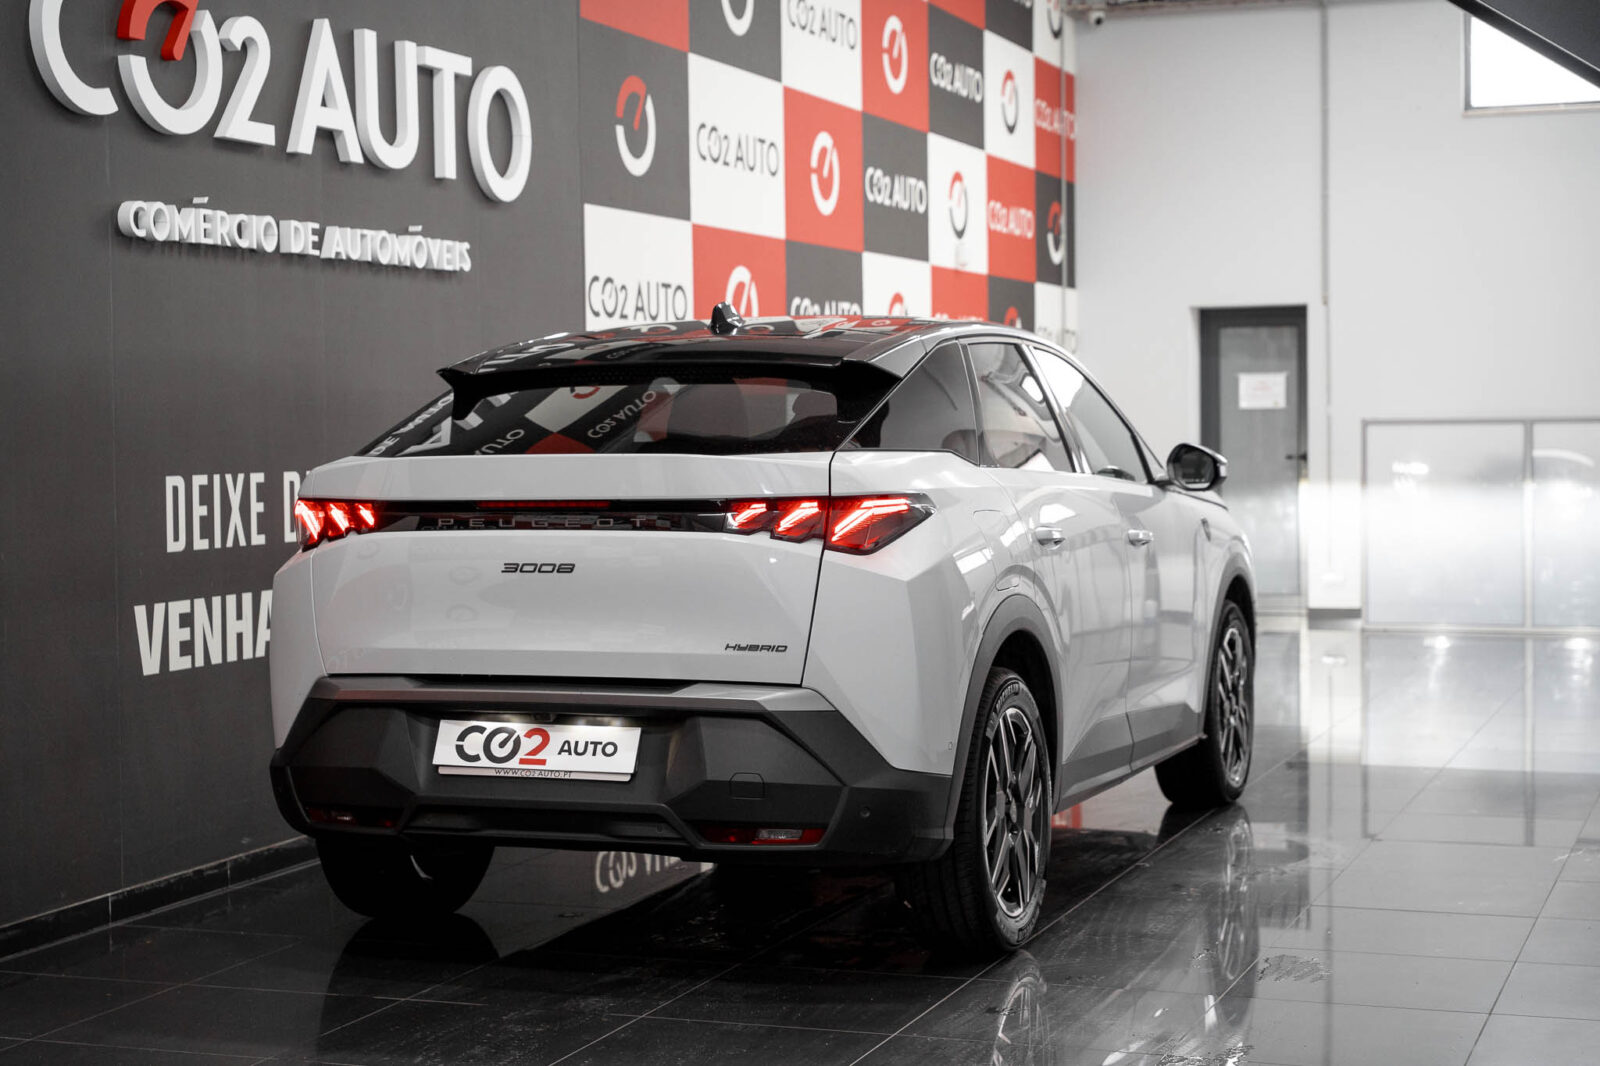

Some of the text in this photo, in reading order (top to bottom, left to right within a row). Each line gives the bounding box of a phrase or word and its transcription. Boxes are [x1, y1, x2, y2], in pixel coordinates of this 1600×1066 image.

[820, 4, 857, 50] AUTO
[29, 0, 532, 202] CO2 AUTO
[953, 62, 984, 103] AUTO
[696, 122, 780, 177] CO2 AUTO
[865, 166, 928, 214] CO2 AUTO
[117, 196, 472, 273] COMÉRCIO DE AUTOMÓVEIS
[1007, 207, 1034, 239] AUTO
[588, 275, 688, 321] CO2 AUTO
[165, 472, 266, 553] DEIXE
[438, 517, 647, 529] PEUGEOT
[501, 562, 576, 574] 3008
[724, 643, 788, 653] HYBRID
[455, 725, 619, 766] CO2 AUTO
